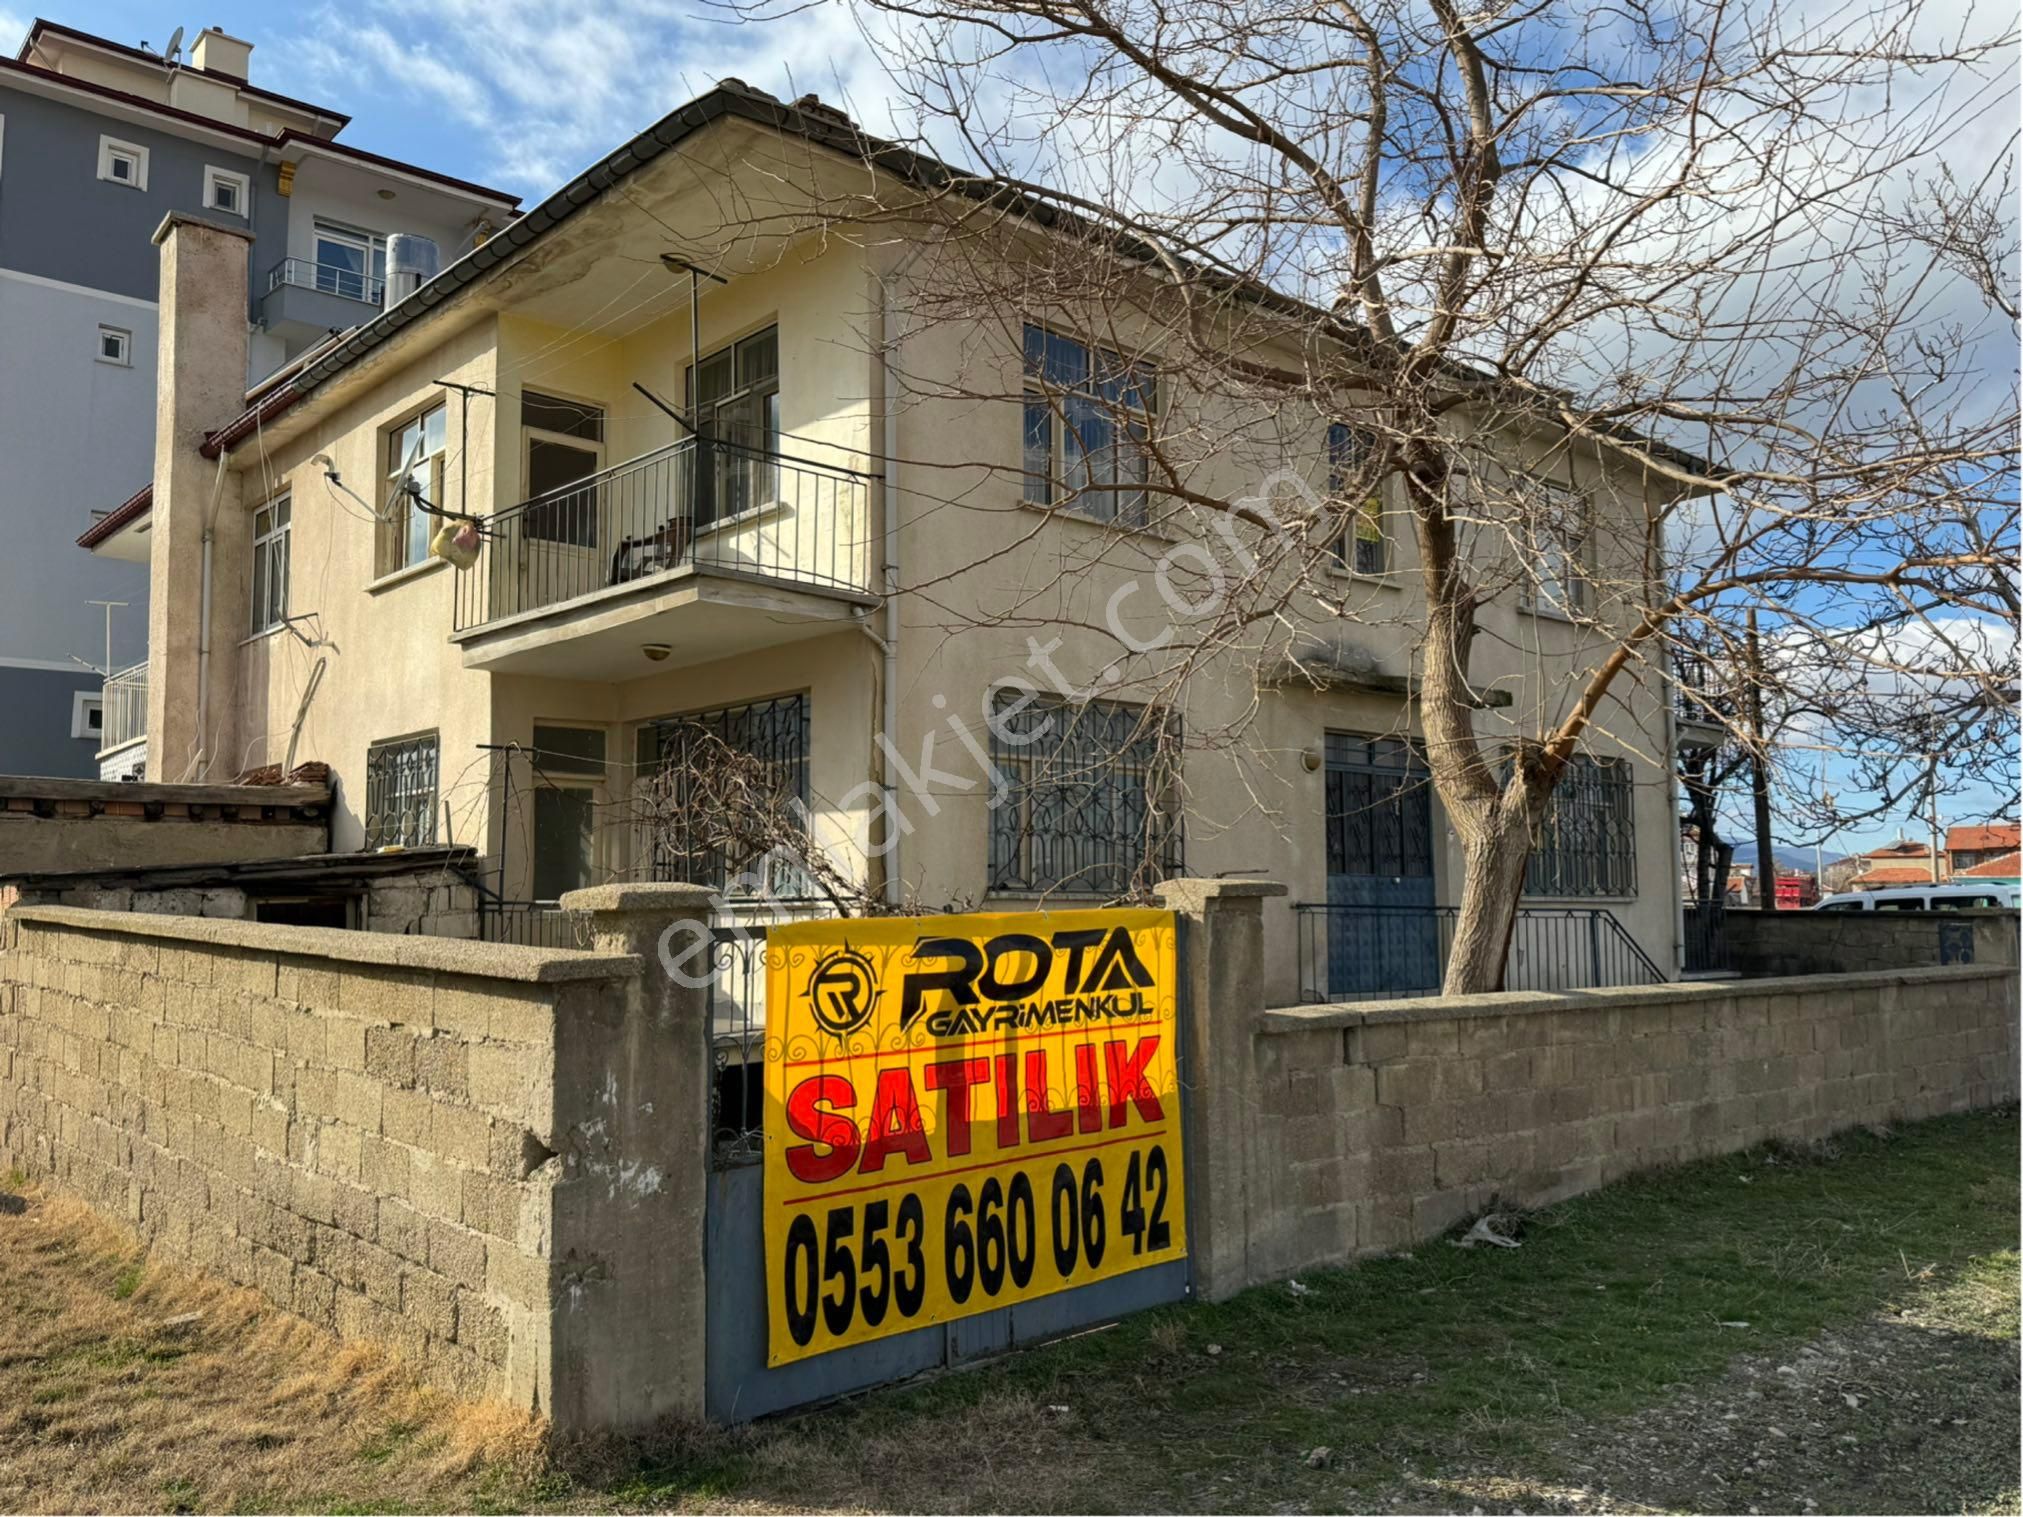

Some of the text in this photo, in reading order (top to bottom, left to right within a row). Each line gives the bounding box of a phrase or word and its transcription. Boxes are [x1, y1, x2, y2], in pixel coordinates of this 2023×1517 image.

[901, 926, 1155, 1034] ROTA
[785, 1035, 1165, 1183] SATILIK
[784, 1144, 1171, 1347] 0553 660 06 42
